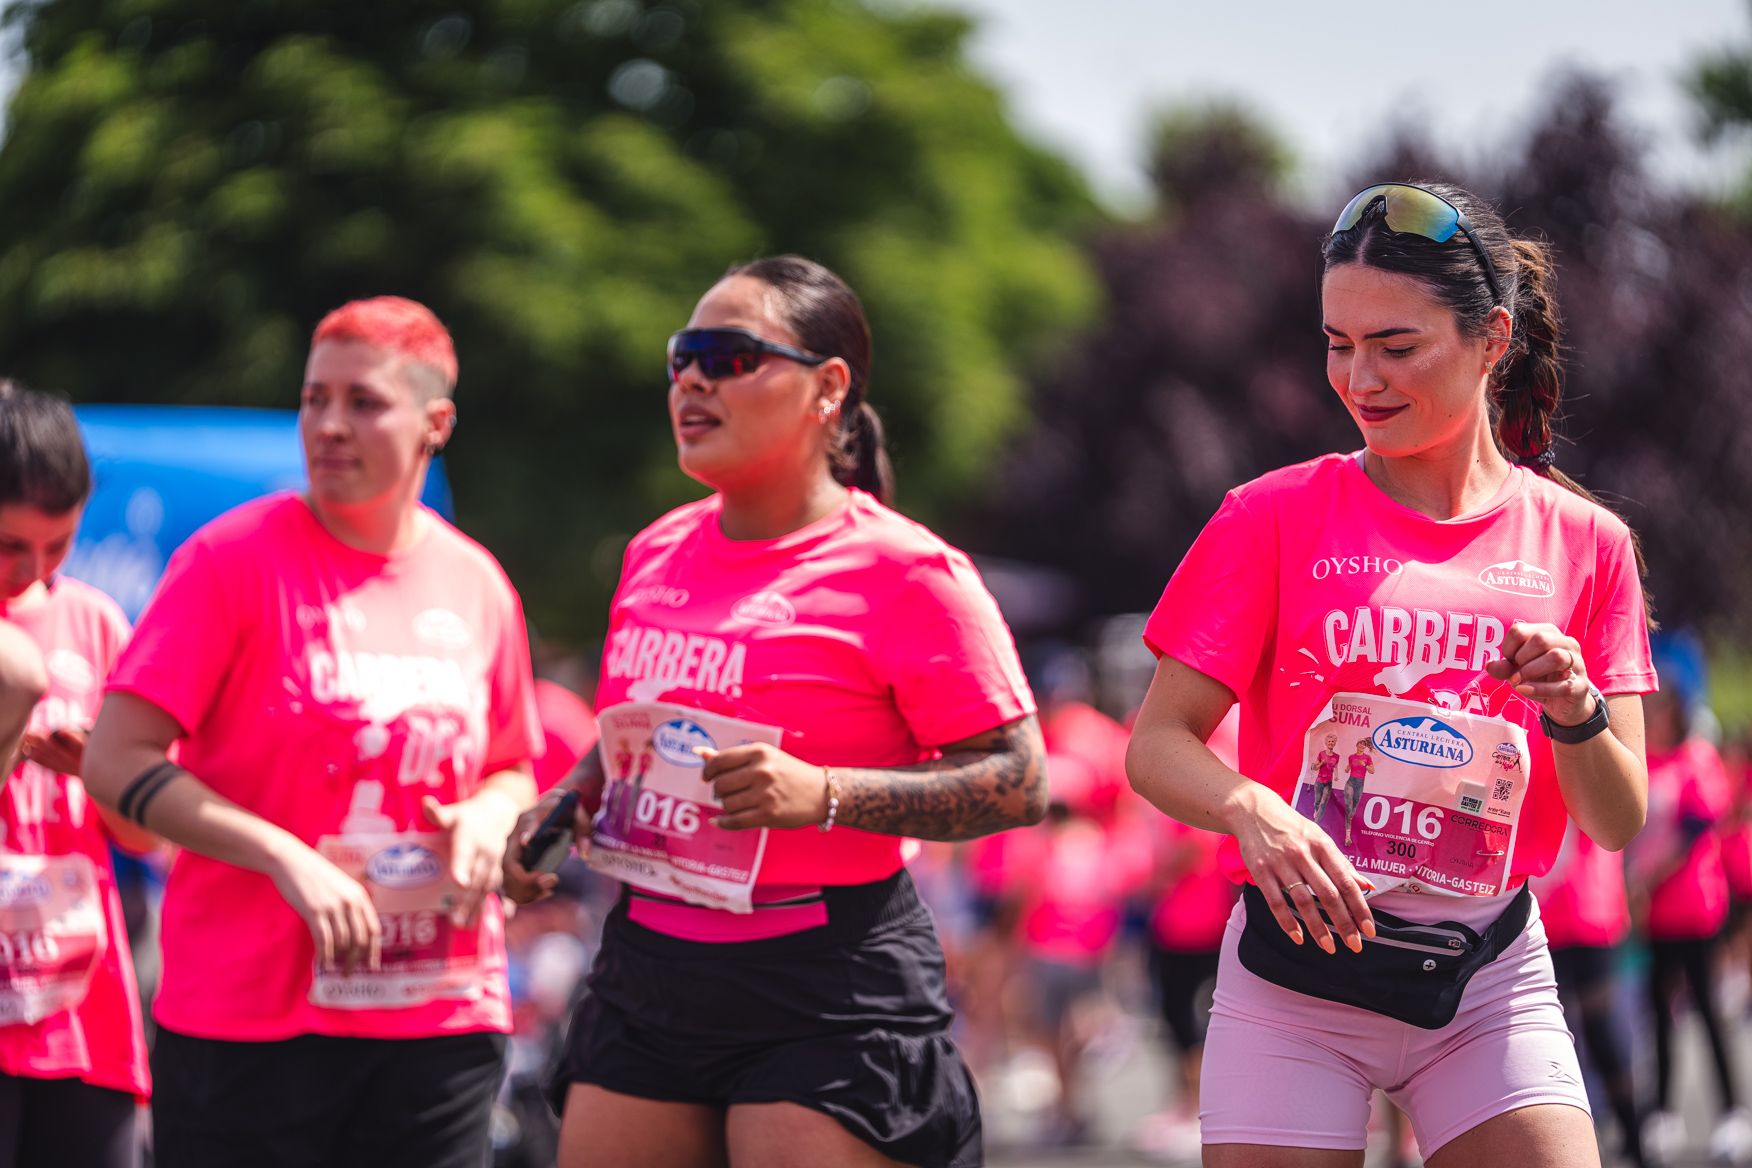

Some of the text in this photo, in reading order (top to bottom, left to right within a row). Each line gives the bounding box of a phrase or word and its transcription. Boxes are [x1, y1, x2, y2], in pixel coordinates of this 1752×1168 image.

[1312, 556, 1404, 580] OYSHO
[1485, 571, 1552, 594] ASTURIANA
[1323, 606, 1508, 672] CARRER
[1328, 710, 1370, 729] SUMA
[1340, 703, 1373, 716] DORSAL
[1379, 728, 1465, 763] ASTURIANA
[1396, 729, 1465, 748] CENTRAL LECHERA
[635, 791, 700, 834] 016
[1363, 796, 1445, 841] 016
[1451, 814, 1509, 837] CORREDORA
[1384, 833, 1411, 842] VIOLENCIA
[1386, 840, 1417, 859] 300
[1355, 856, 1369, 868] LA
[1370, 858, 1407, 875] MUJER
[1415, 865, 1497, 895] ITORIA-GASTEIZ
